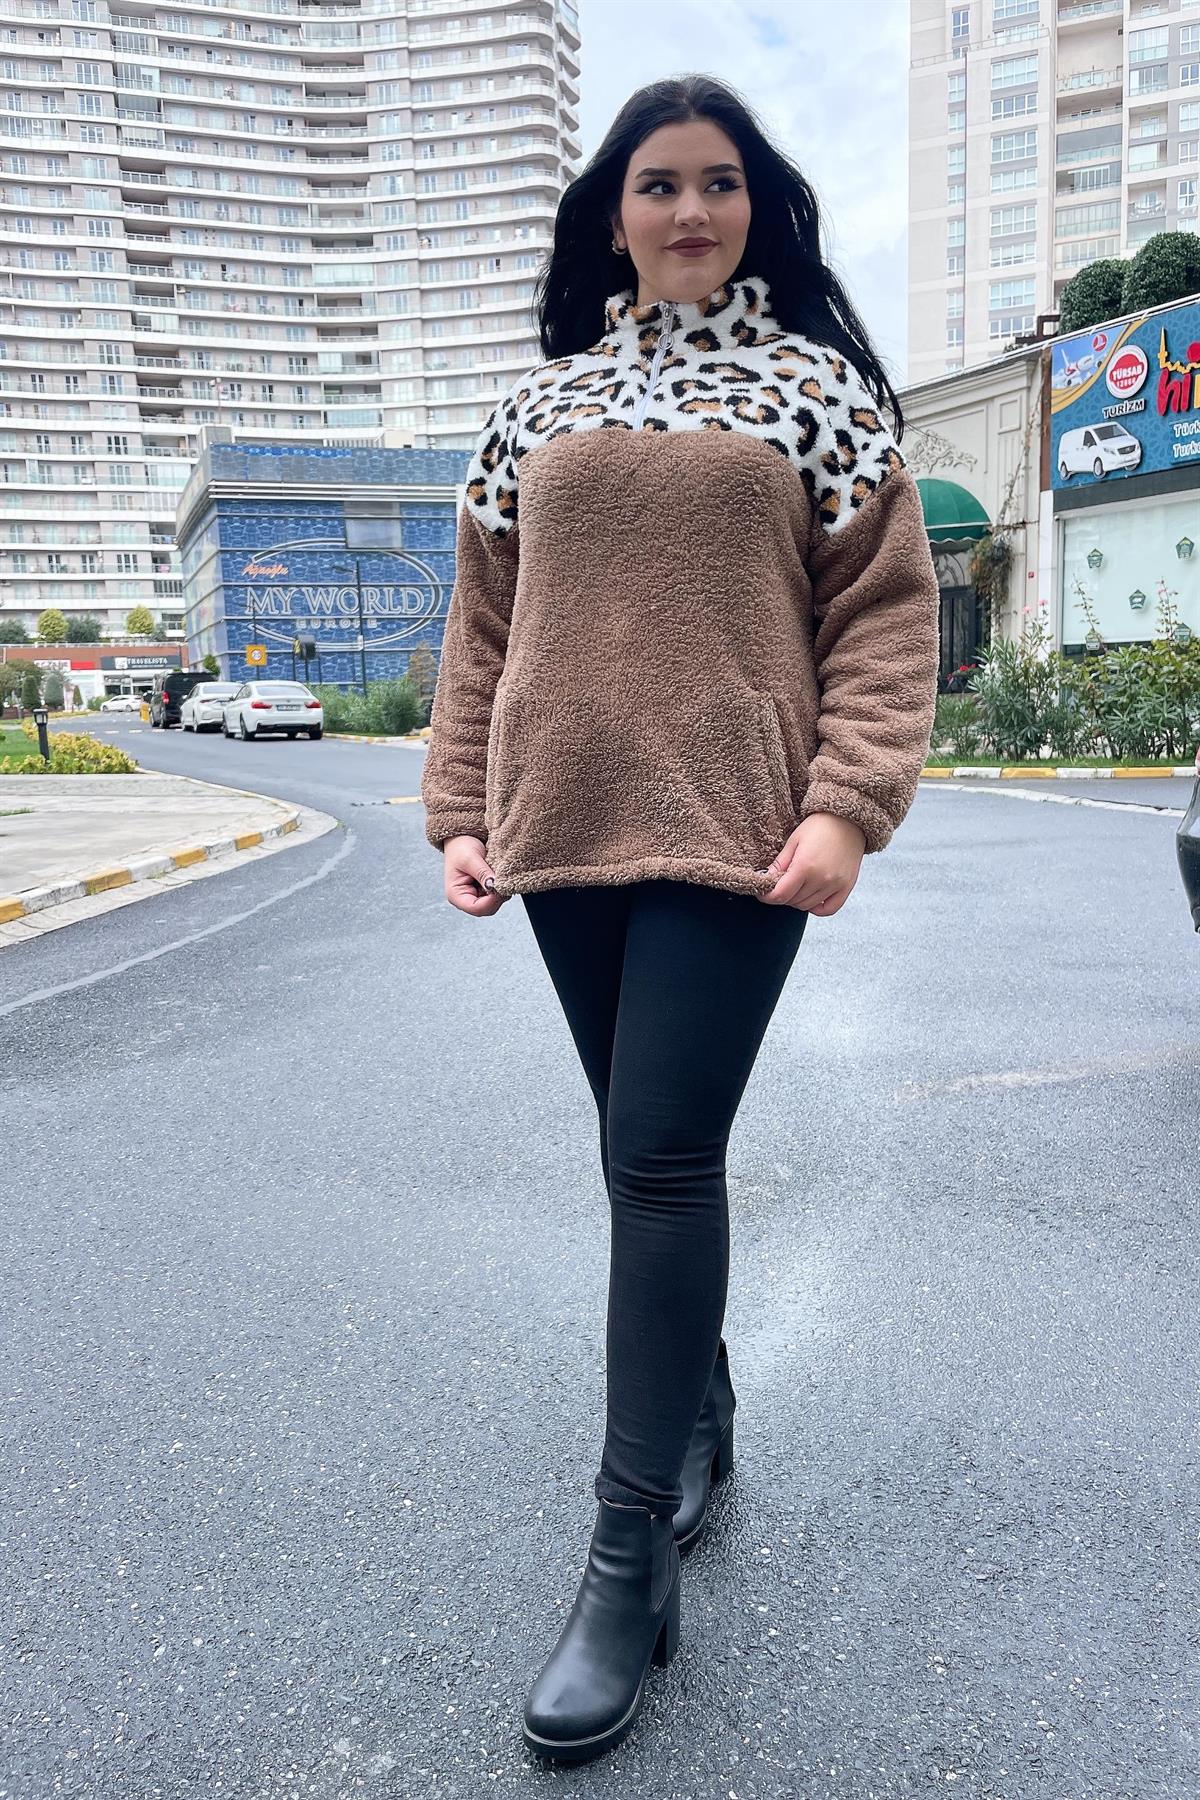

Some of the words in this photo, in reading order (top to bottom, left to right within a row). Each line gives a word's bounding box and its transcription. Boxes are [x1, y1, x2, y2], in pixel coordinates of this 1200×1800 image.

[1102, 399, 1144, 418] TURİZM
[244, 587, 298, 614] MY
[301, 587, 425, 614] WORLD
